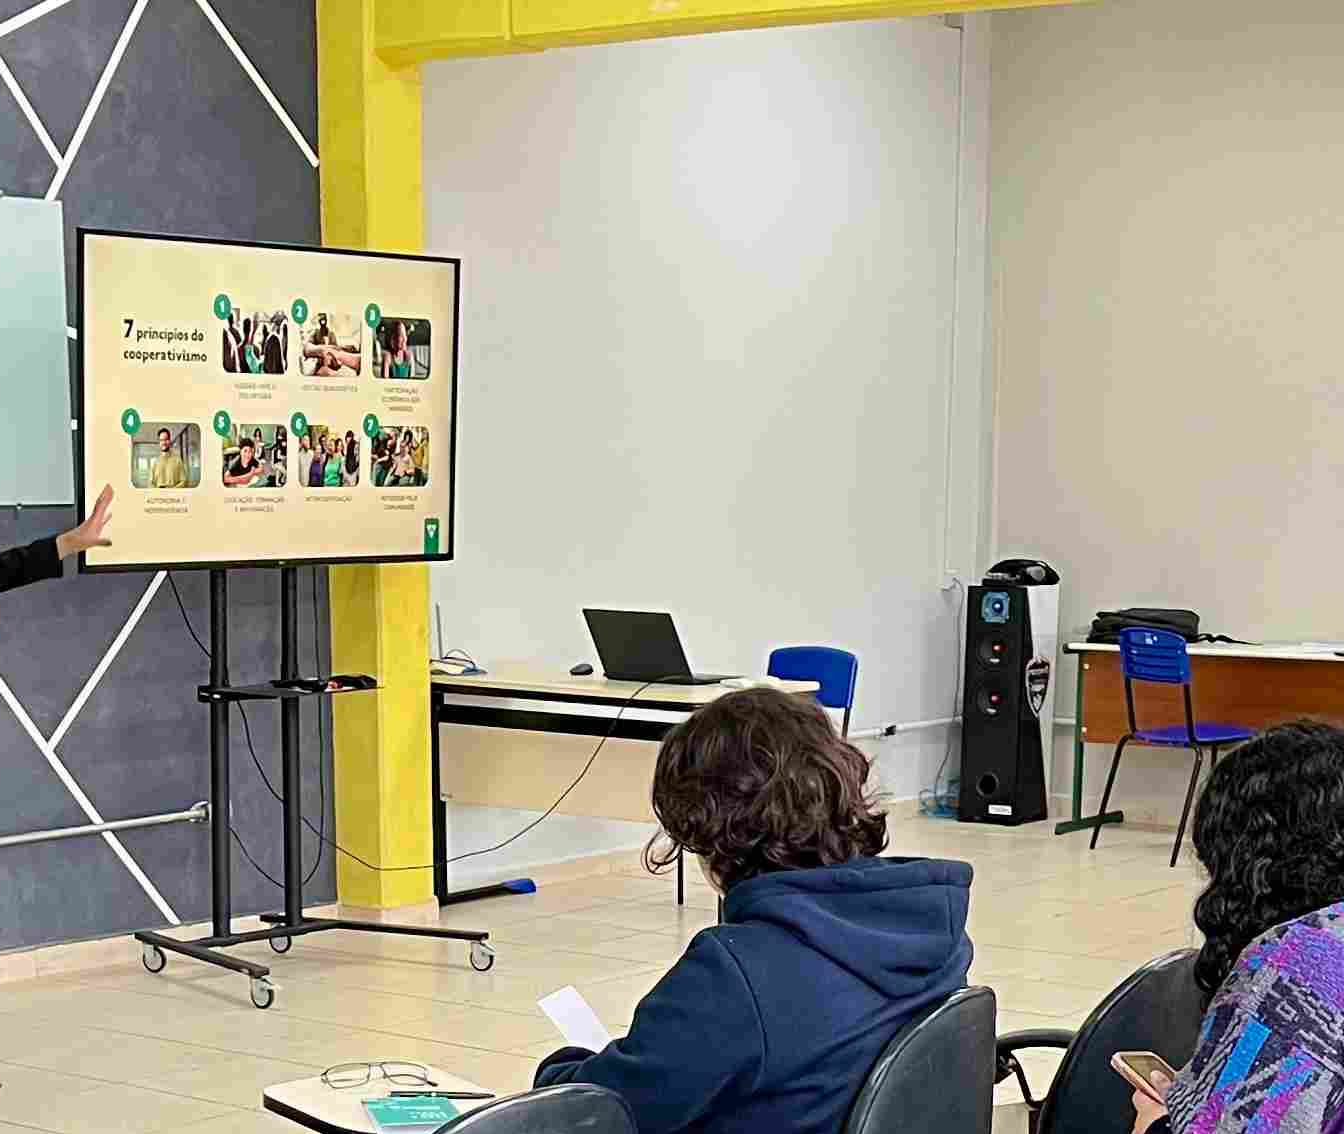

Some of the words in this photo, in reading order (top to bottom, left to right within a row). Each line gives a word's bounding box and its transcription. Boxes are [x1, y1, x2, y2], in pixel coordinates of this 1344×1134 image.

[295, 305, 303, 317] 2
[123, 318, 135, 338] 7
[123, 348, 208, 365] cooperativismo
[126, 414, 134, 426] 4
[218, 415, 225, 428] 5
[295, 418, 303, 430] 6
[367, 419, 374, 431] 7
